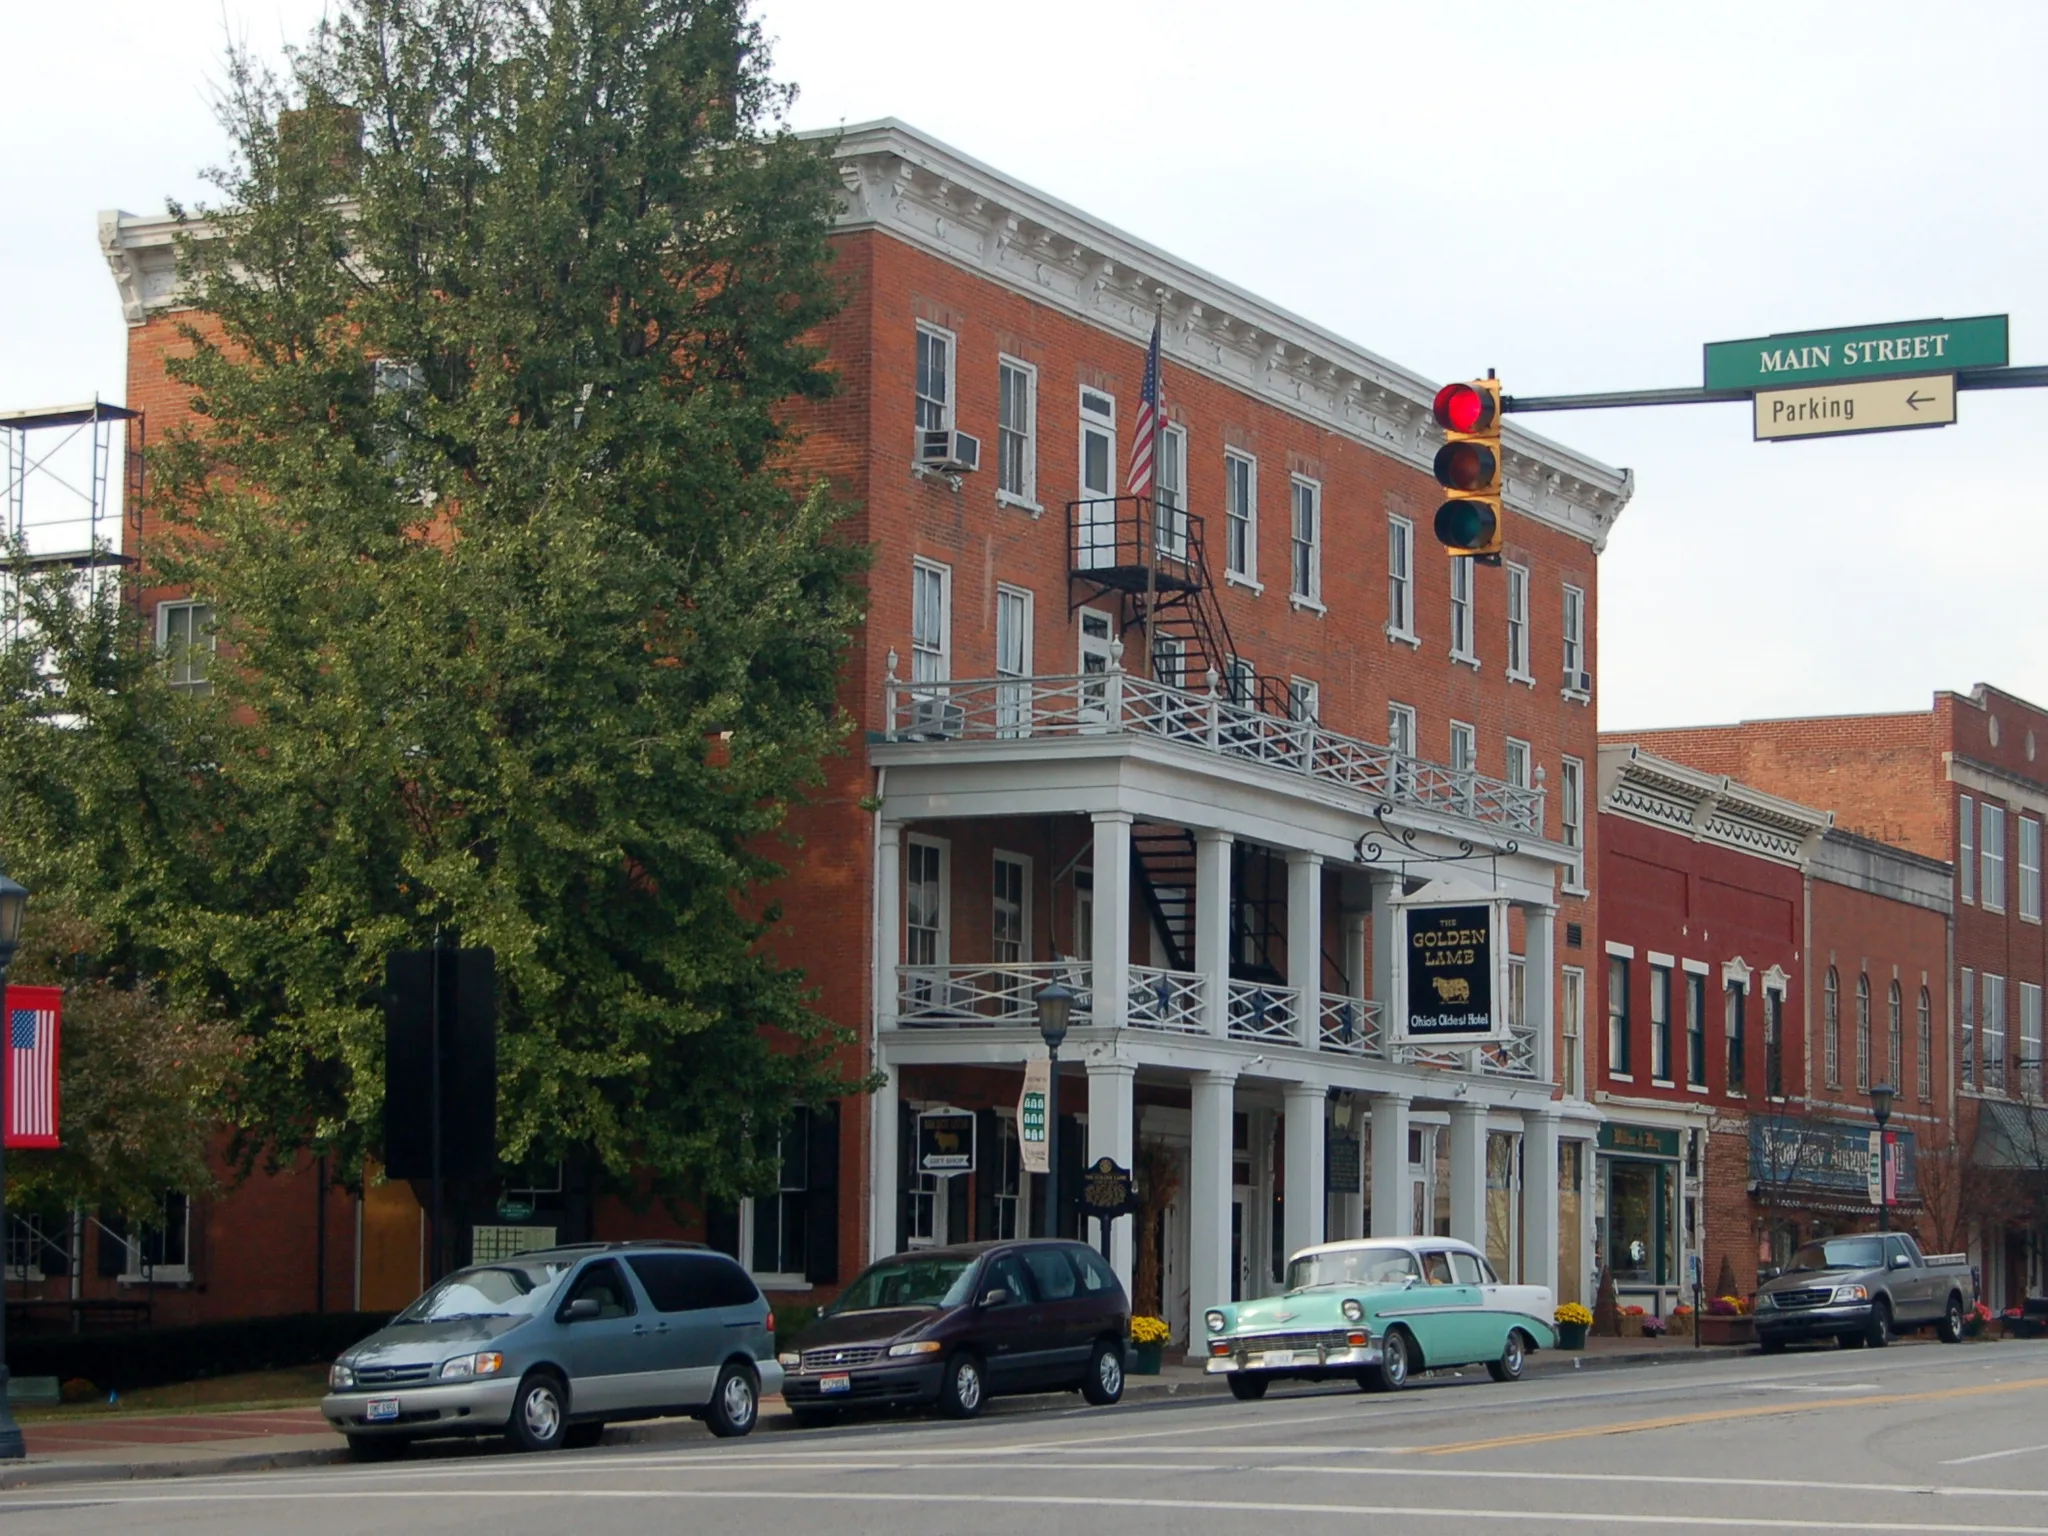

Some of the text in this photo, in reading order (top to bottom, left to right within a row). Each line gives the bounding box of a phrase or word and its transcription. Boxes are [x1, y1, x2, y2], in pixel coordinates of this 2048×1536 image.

[1759, 333, 1949, 373] MAIN STREET
[1773, 398, 1855, 423] Parking
[1413, 929, 1486, 948] GOLDEN
[1425, 949, 1475, 966] LAMB
[1411, 1012, 1489, 1027] Ohio's Oldest Hotel
[930, 1157, 964, 1165] GIFT SHOP
[1831, 1139, 1869, 1175] Antiqu
